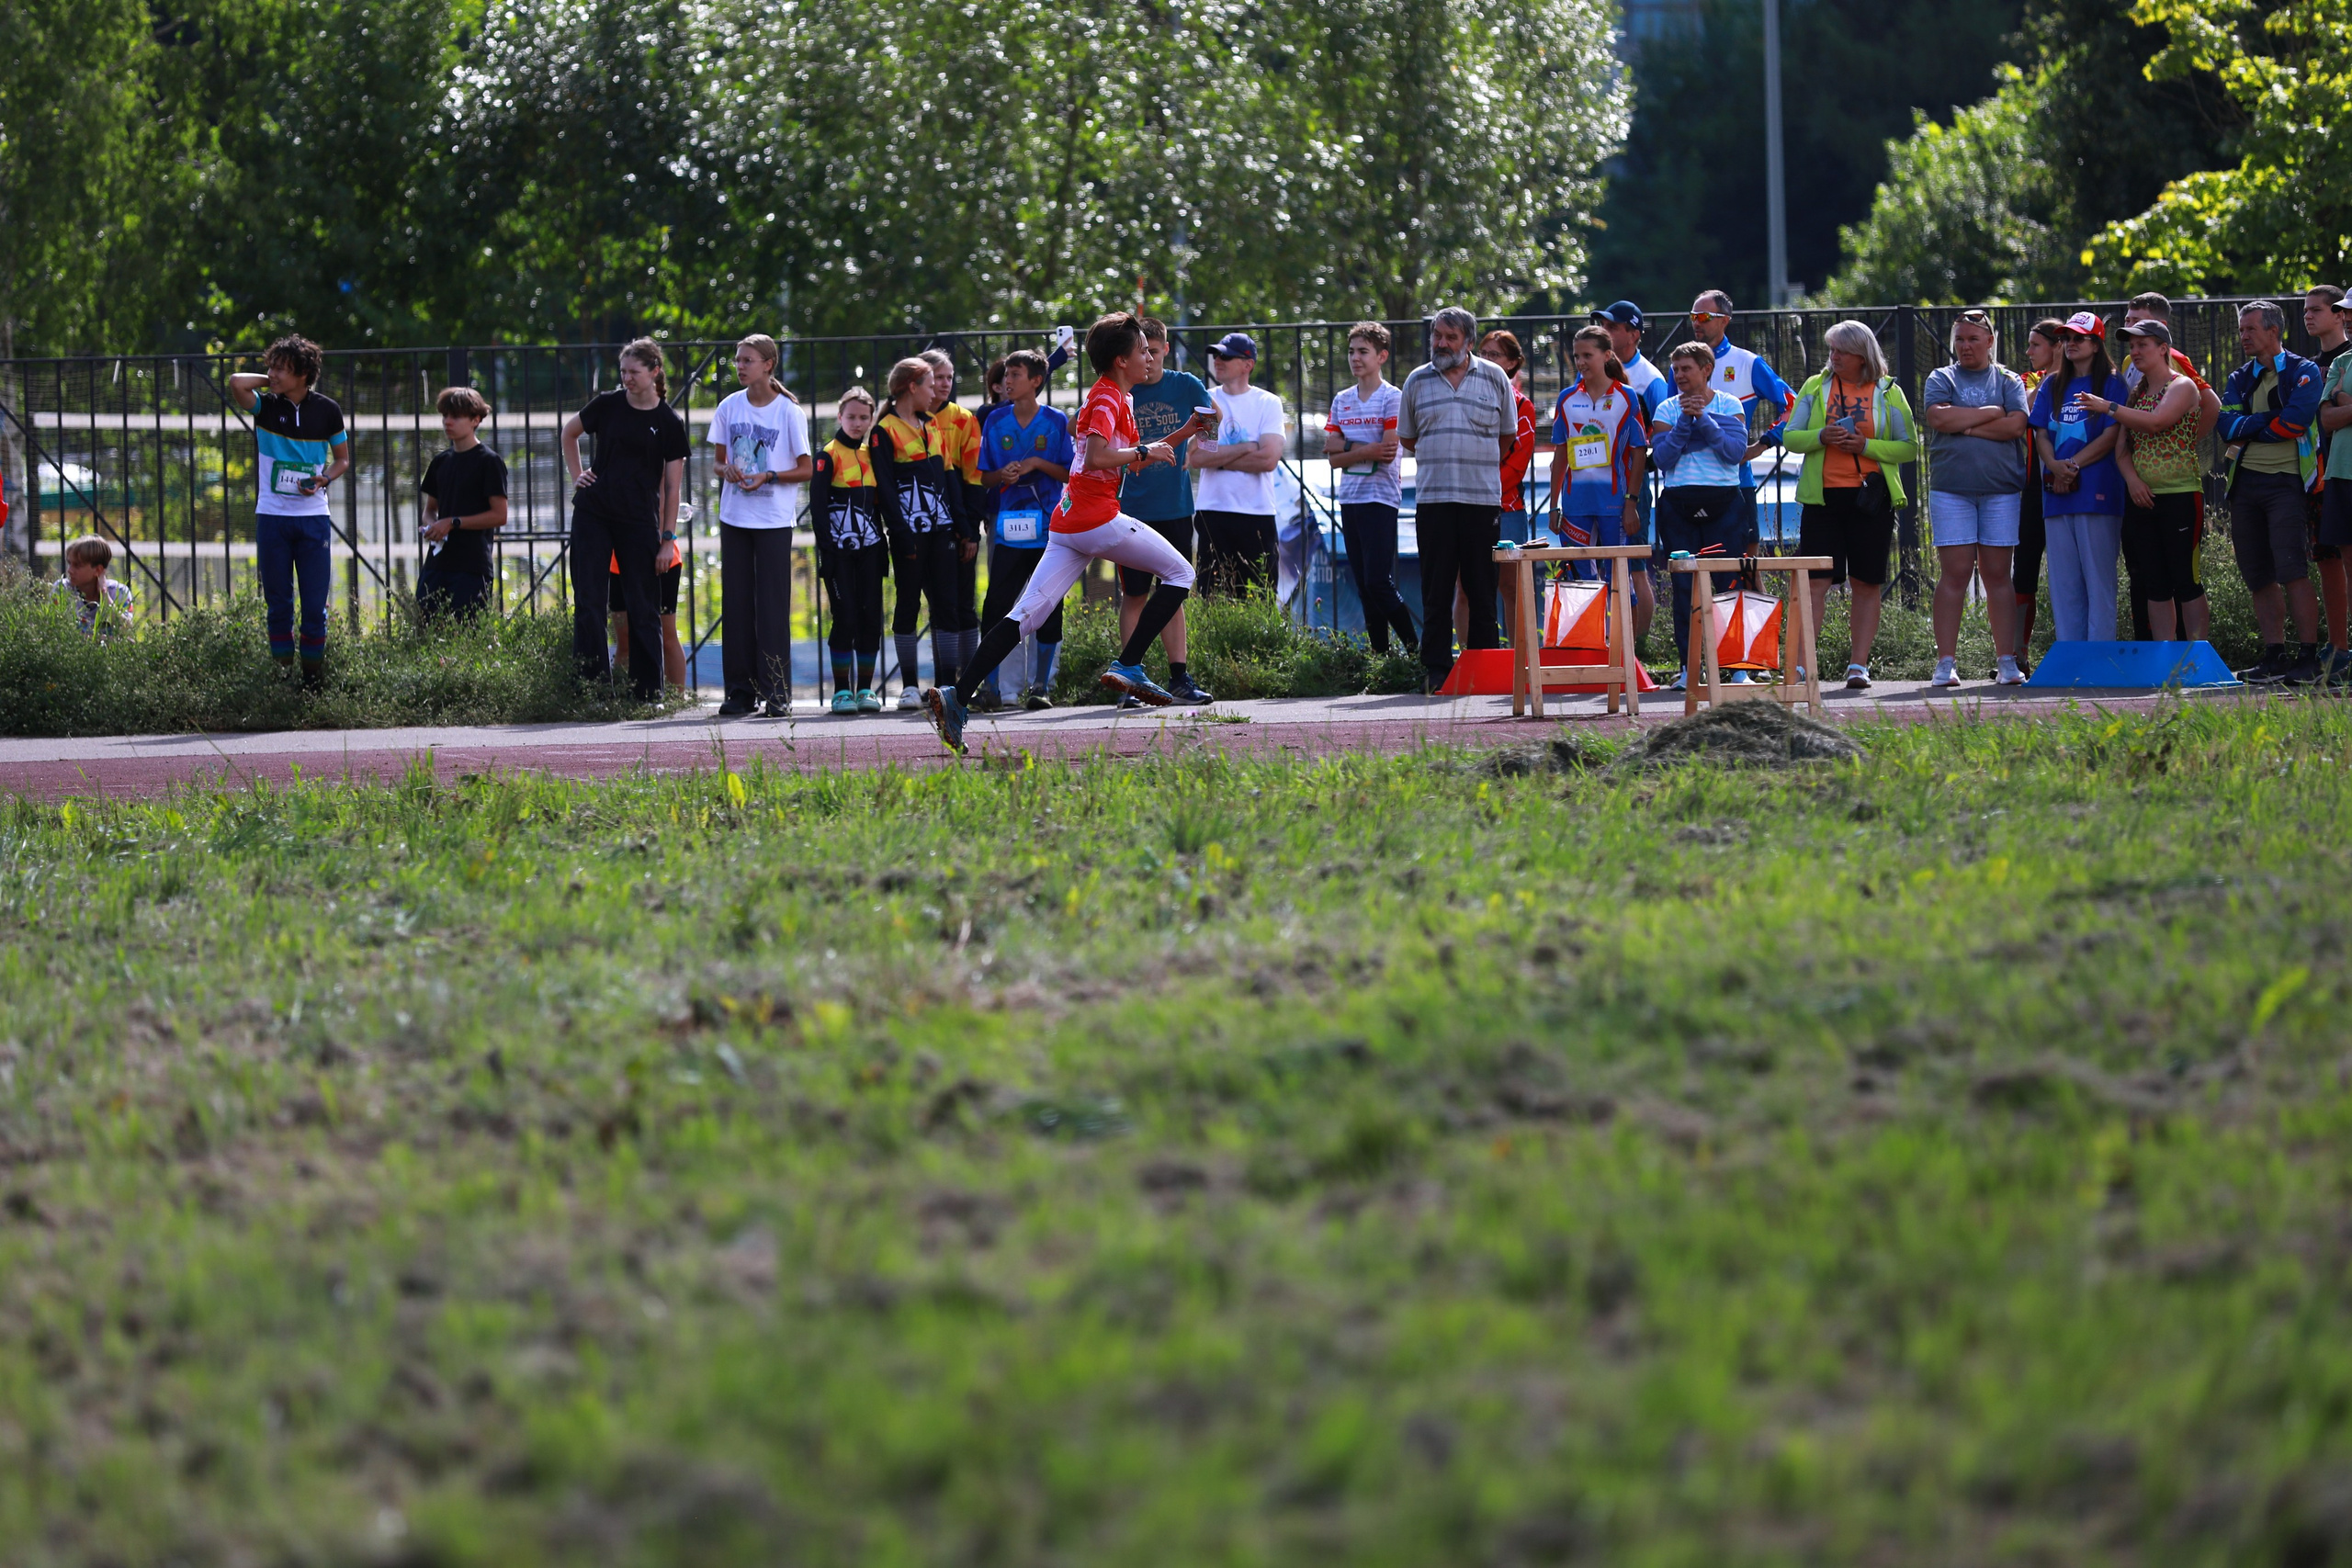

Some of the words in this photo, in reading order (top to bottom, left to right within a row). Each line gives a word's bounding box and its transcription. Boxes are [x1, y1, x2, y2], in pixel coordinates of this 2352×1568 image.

[2061, 405, 2083, 413] SPOR
[1136, 416, 1152, 428] EE
[1156, 412, 1182, 426] SOUL
[1363, 417, 1385, 425] WES
[1578, 446, 1598, 457] 220.1
[1009, 524, 1029, 532] 311.3
